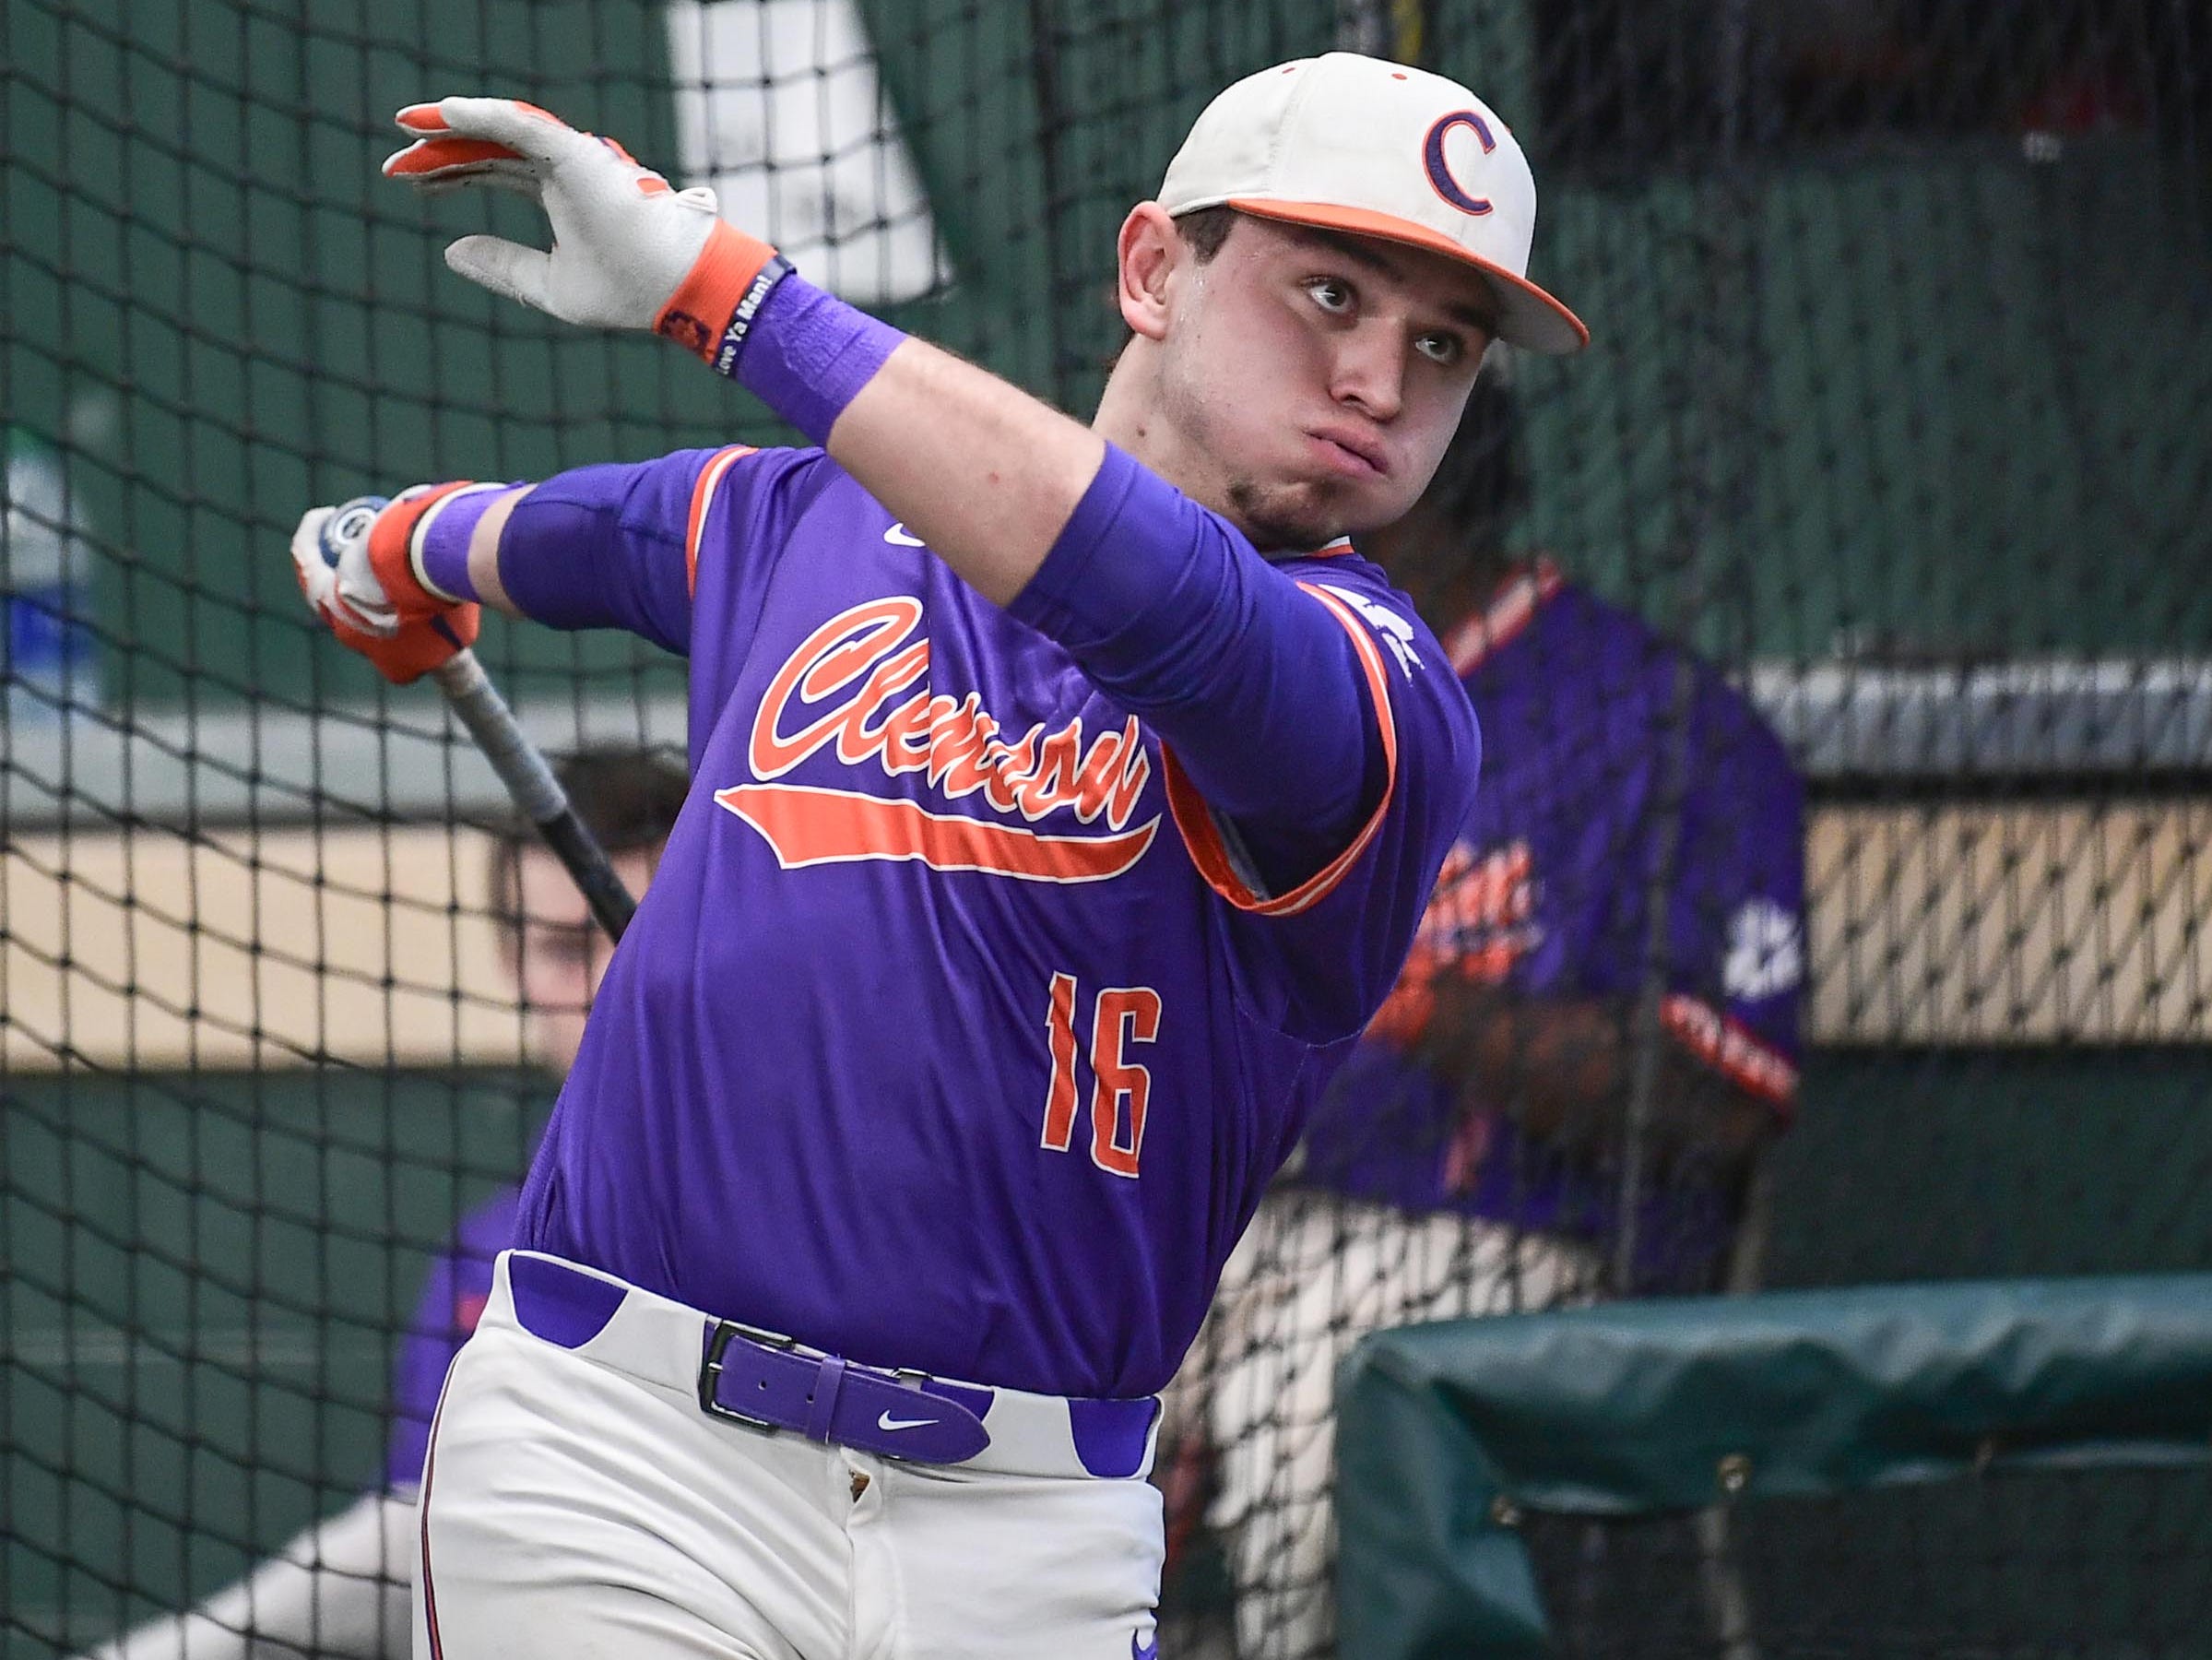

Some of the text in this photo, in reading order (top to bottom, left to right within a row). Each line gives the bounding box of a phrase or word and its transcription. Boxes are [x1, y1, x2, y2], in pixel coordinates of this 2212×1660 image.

[1422, 109, 1496, 216] C
[725, 321, 748, 341] Ya
[750, 596, 1153, 832] Clemson
[1040, 970, 1162, 1179] 16
